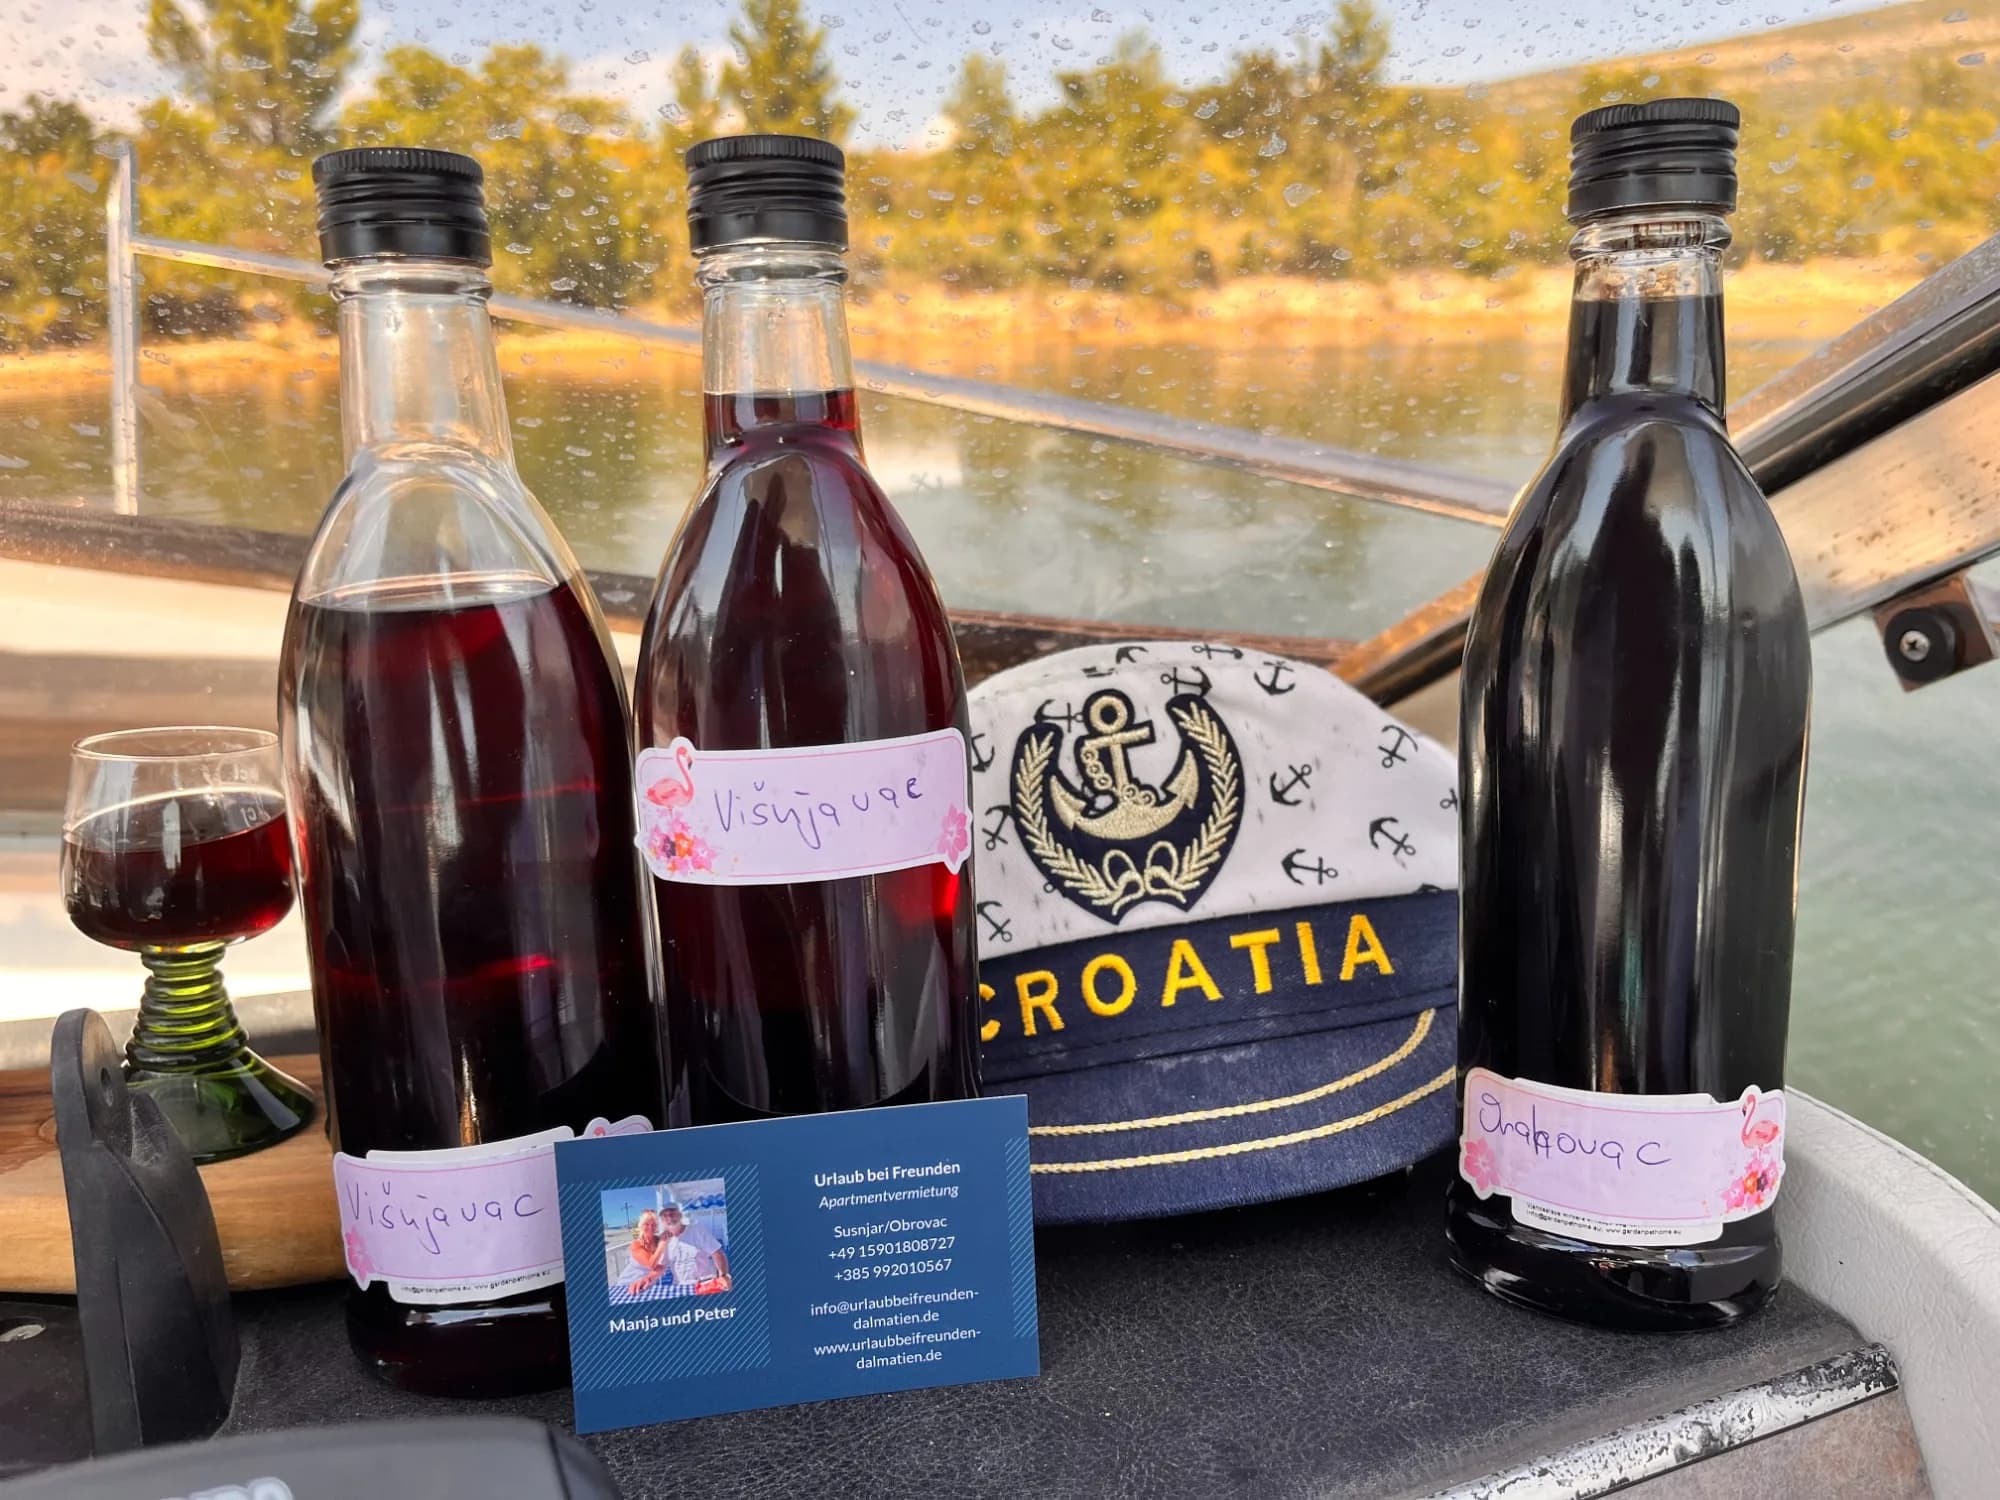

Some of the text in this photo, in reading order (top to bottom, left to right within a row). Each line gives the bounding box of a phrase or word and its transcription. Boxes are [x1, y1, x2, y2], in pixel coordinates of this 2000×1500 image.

[814, 1162, 961, 1187] Urlaub bei Freunden
[818, 1184, 959, 1210] Apartmentvermietung
[833, 1216, 948, 1239] Susnjar/Obrovac
[828, 1236, 956, 1260] +49 15901808727
[834, 1258, 953, 1281] +385 992010567
[810, 1288, 979, 1316] info@urlaubbeifreunden-
[609, 1305, 737, 1334] Manja und Peter
[853, 1310, 940, 1330] dalmatien.de
[814, 1327, 982, 1356] www.urlaubbeifreunden-
[856, 1350, 943, 1370] dalmatien.de
